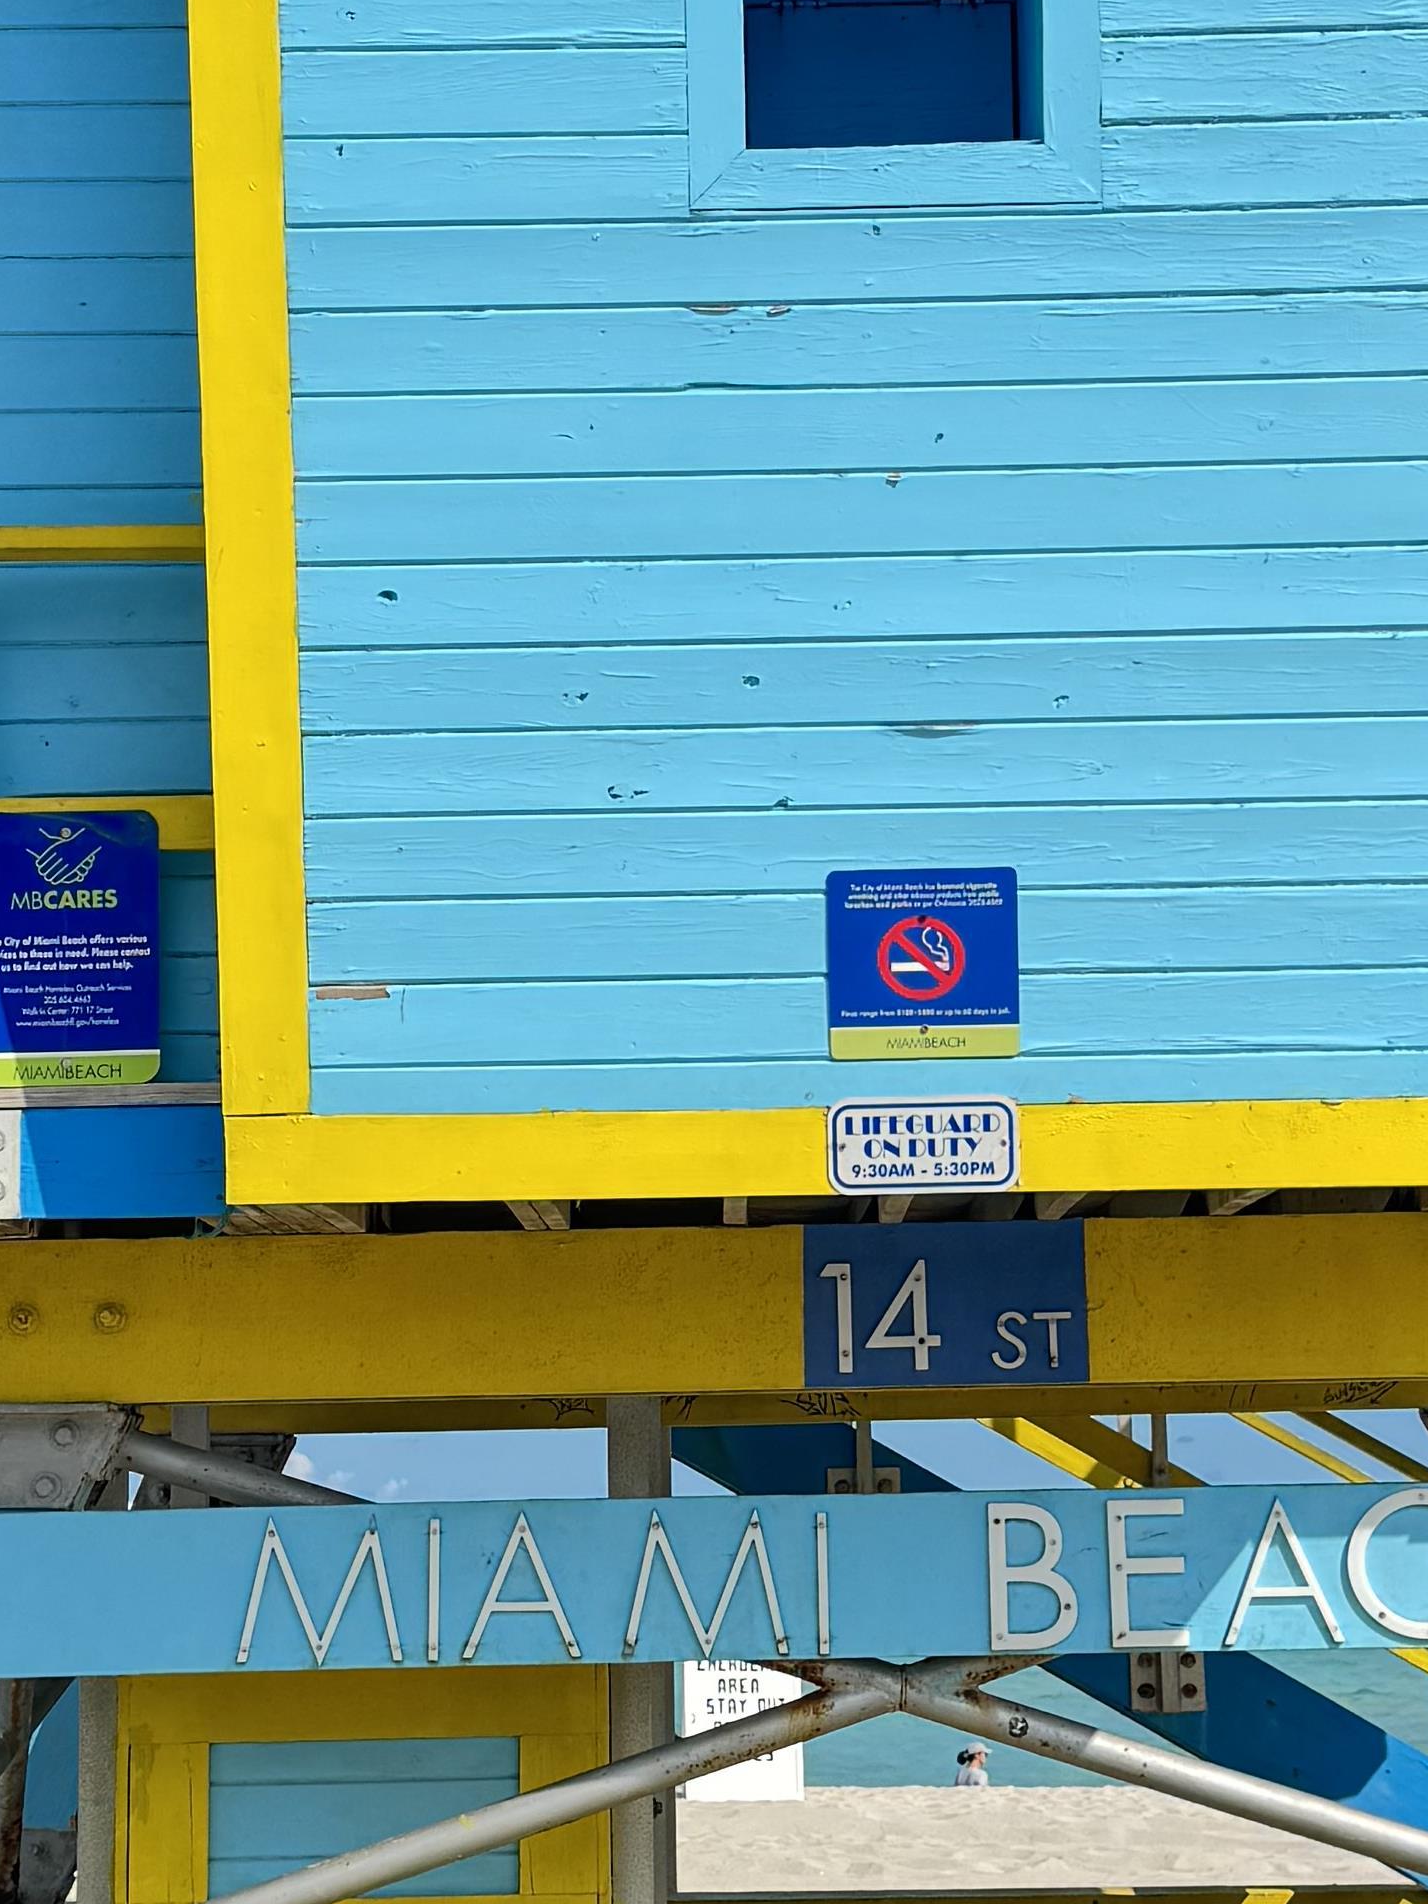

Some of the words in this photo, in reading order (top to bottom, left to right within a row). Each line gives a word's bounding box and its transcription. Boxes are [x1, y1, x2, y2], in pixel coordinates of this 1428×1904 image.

[10, 889, 118, 911] MBCARES
[4, 936, 20, 949] City
[22, 935, 32, 946] of
[89, 933, 114, 944] offers
[19, 950, 28, 959] to
[844, 1112, 1001, 1136] LIFEGUARD
[863, 1138, 901, 1160] ON
[908, 1137, 983, 1158] DUTY
[851, 1163, 915, 1178] 9:30AM
[934, 1161, 995, 1176] 5:30PM
[820, 1259, 941, 1374] 14
[991, 1311, 1072, 1370] ST
[234, 1508, 830, 1667] MIAMI
[717, 1678, 759, 1694] AREA
[706, 1698, 746, 1714] STAY
